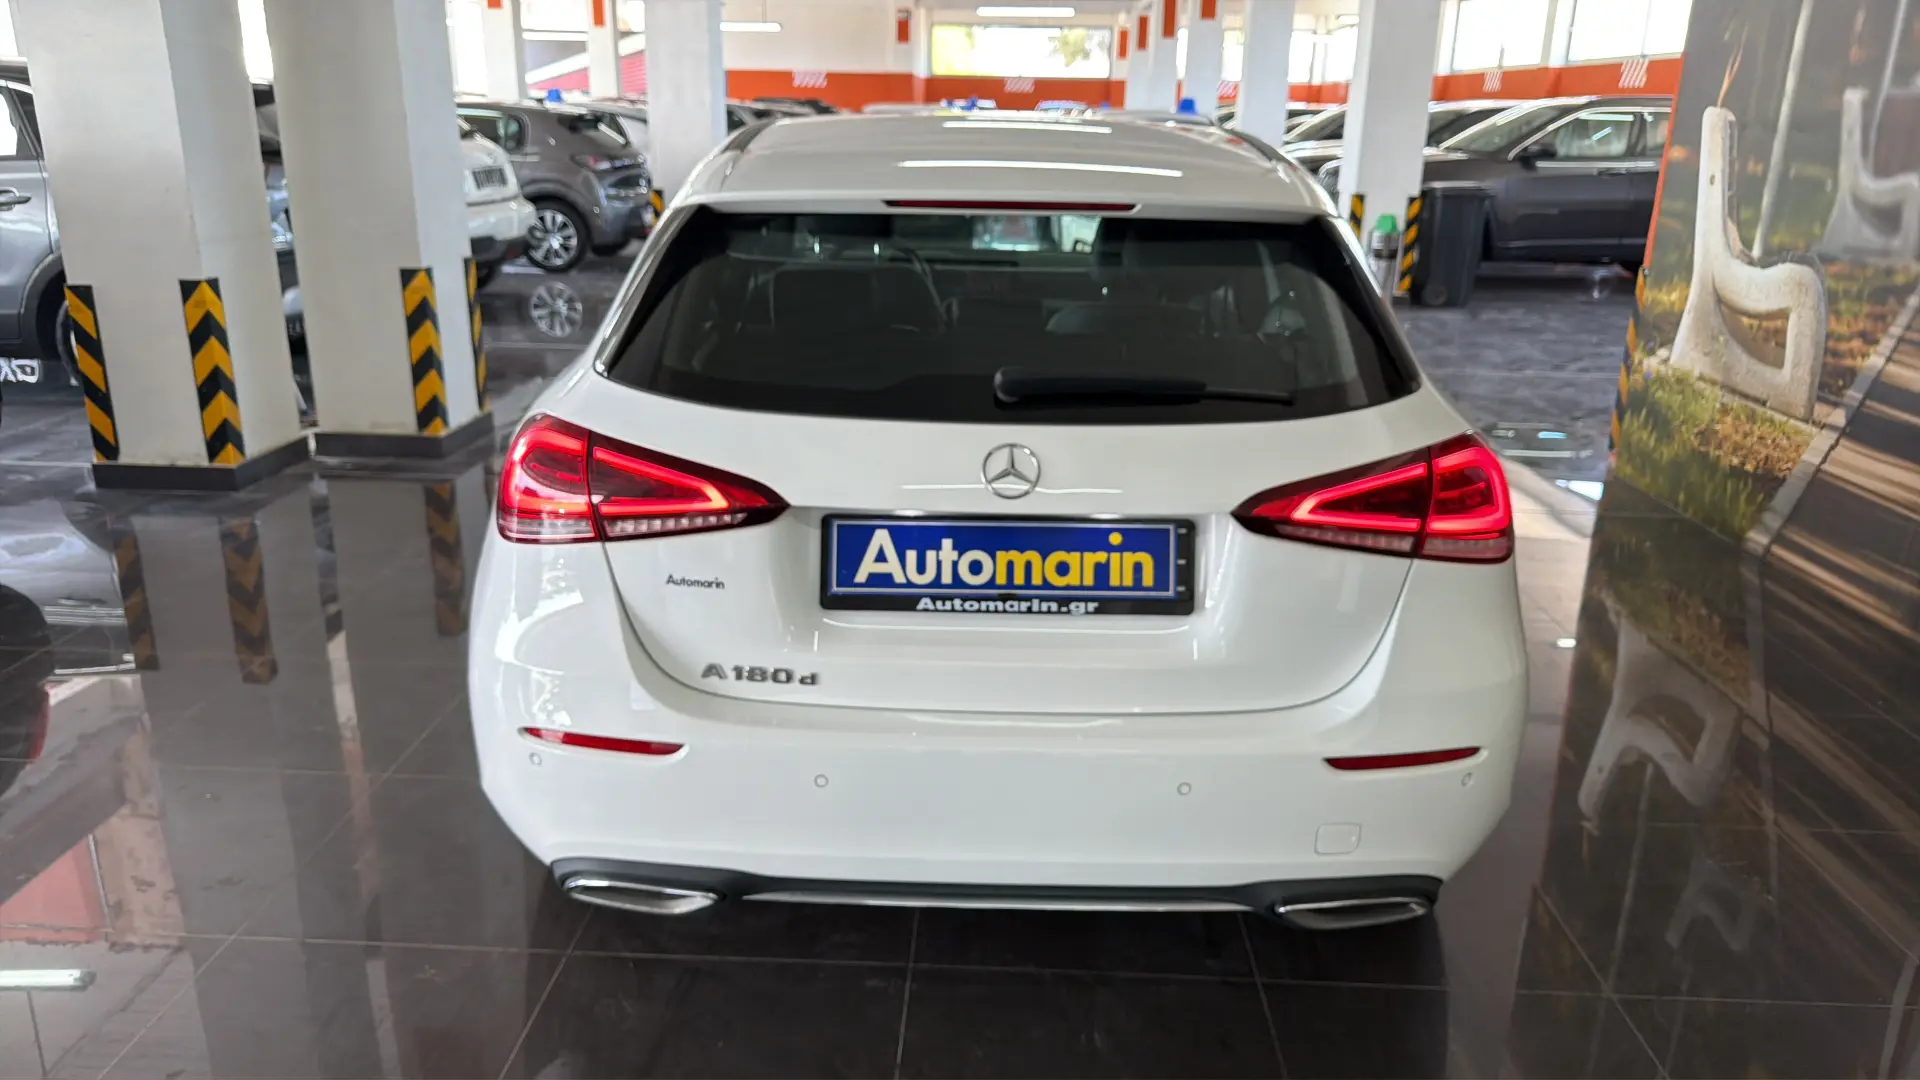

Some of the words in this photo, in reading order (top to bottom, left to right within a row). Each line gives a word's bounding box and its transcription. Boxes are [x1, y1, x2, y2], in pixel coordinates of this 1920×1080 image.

[853, 528, 1154, 587] Automarin
[665, 573, 726, 590] Automarin
[916, 596, 1099, 616] Automarin.gr
